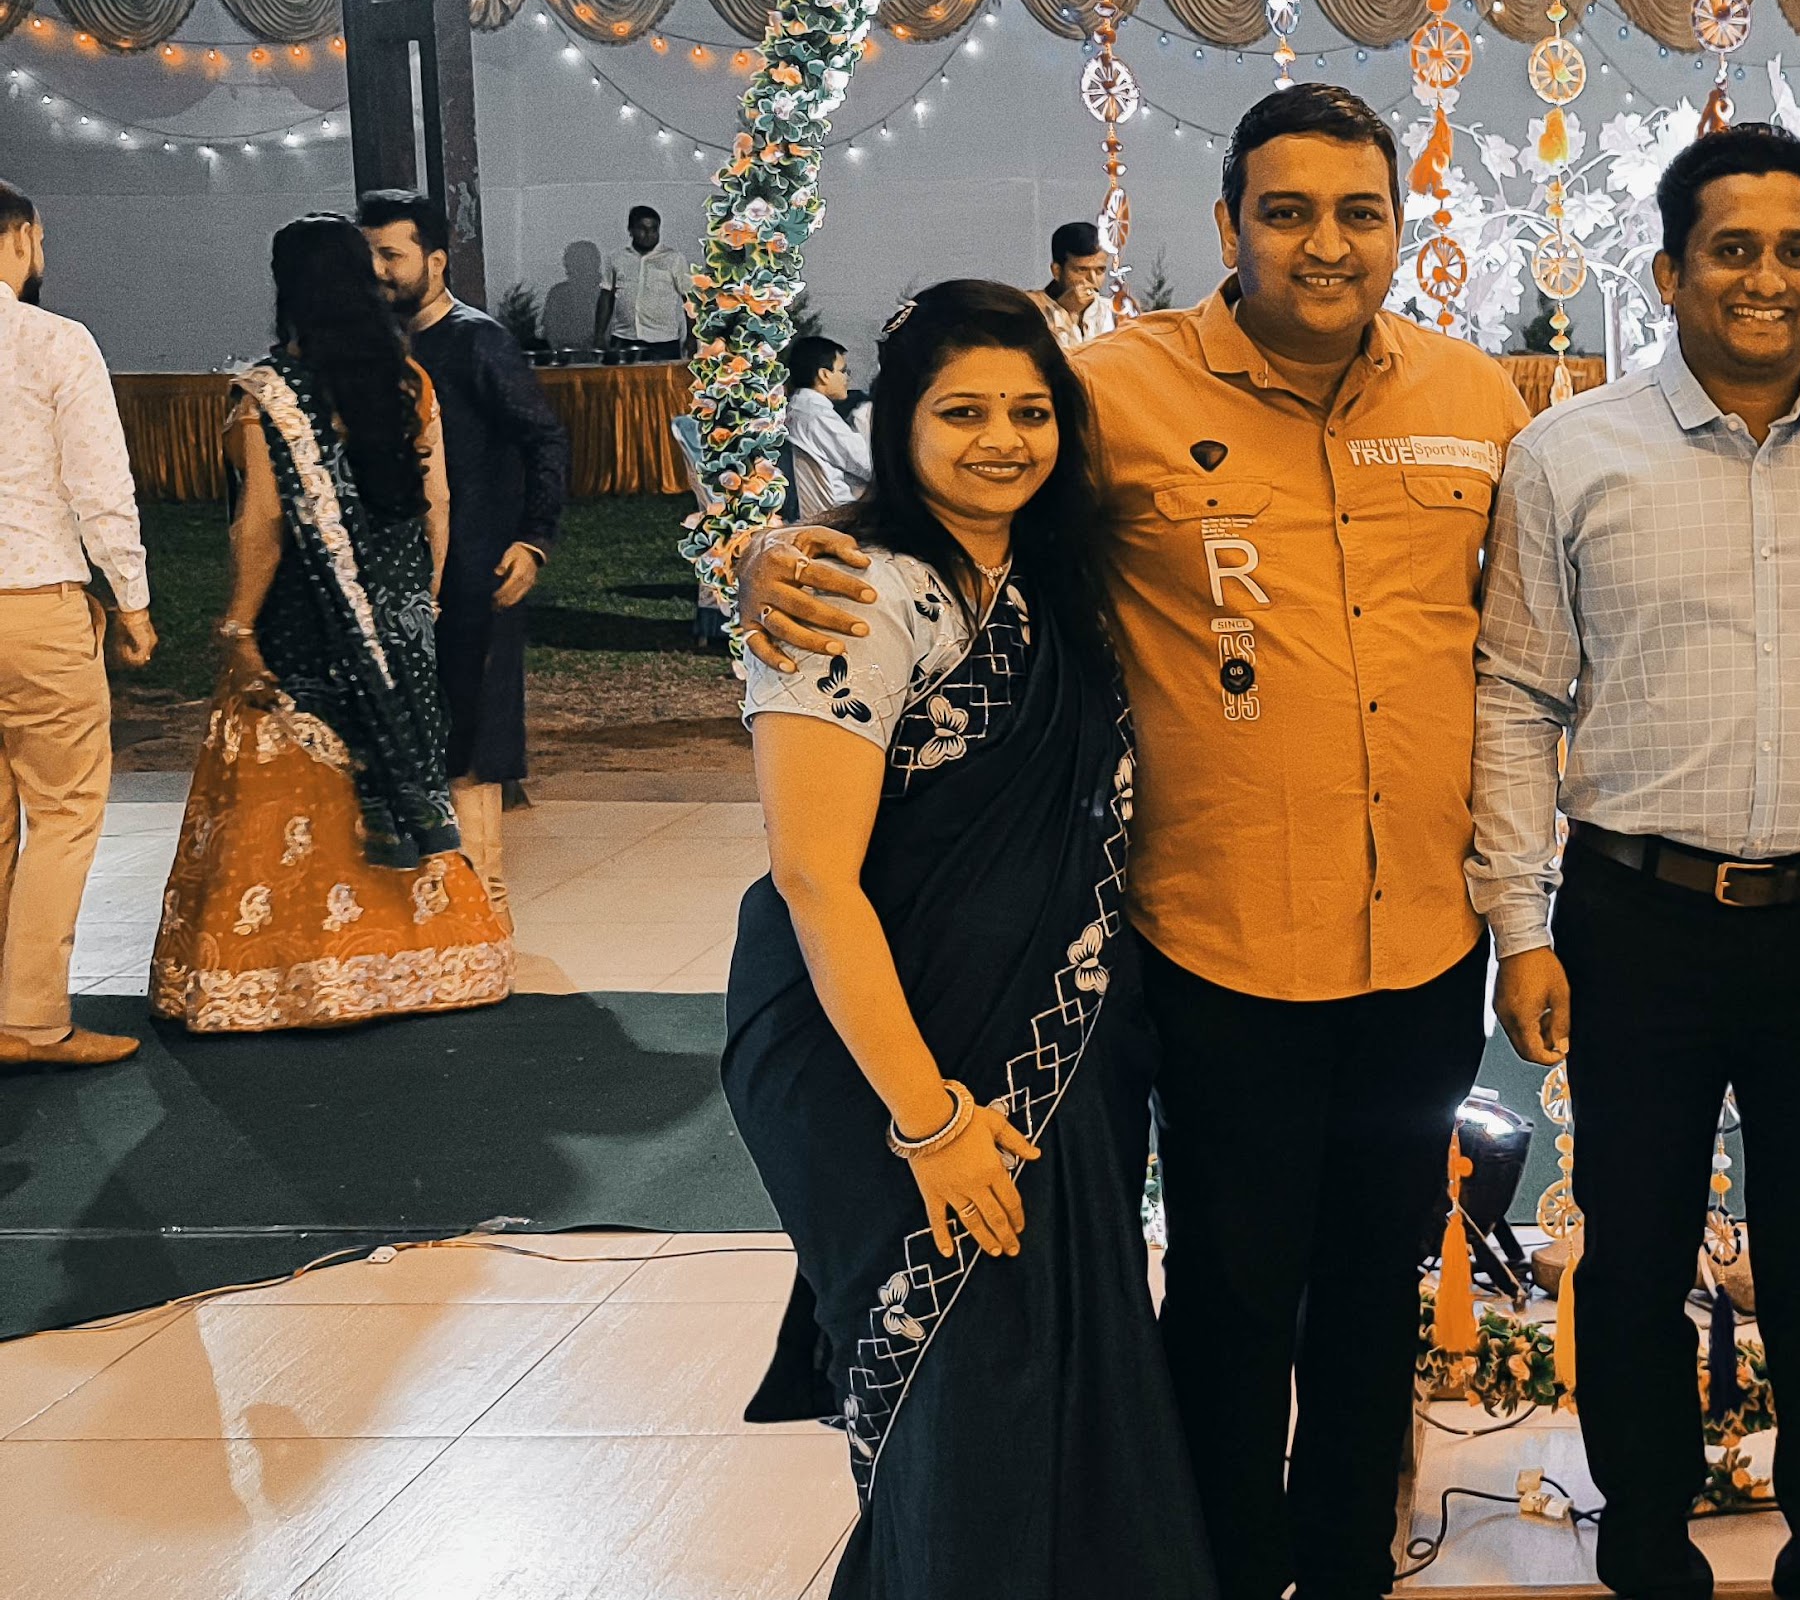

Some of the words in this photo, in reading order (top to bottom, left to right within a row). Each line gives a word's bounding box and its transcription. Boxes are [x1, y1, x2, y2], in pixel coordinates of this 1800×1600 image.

[1350, 446, 1416, 466] TRUE
[1413, 442, 1456, 458] Sports
[1203, 539, 1271, 607] R
[1217, 620, 1250, 630] SINCE
